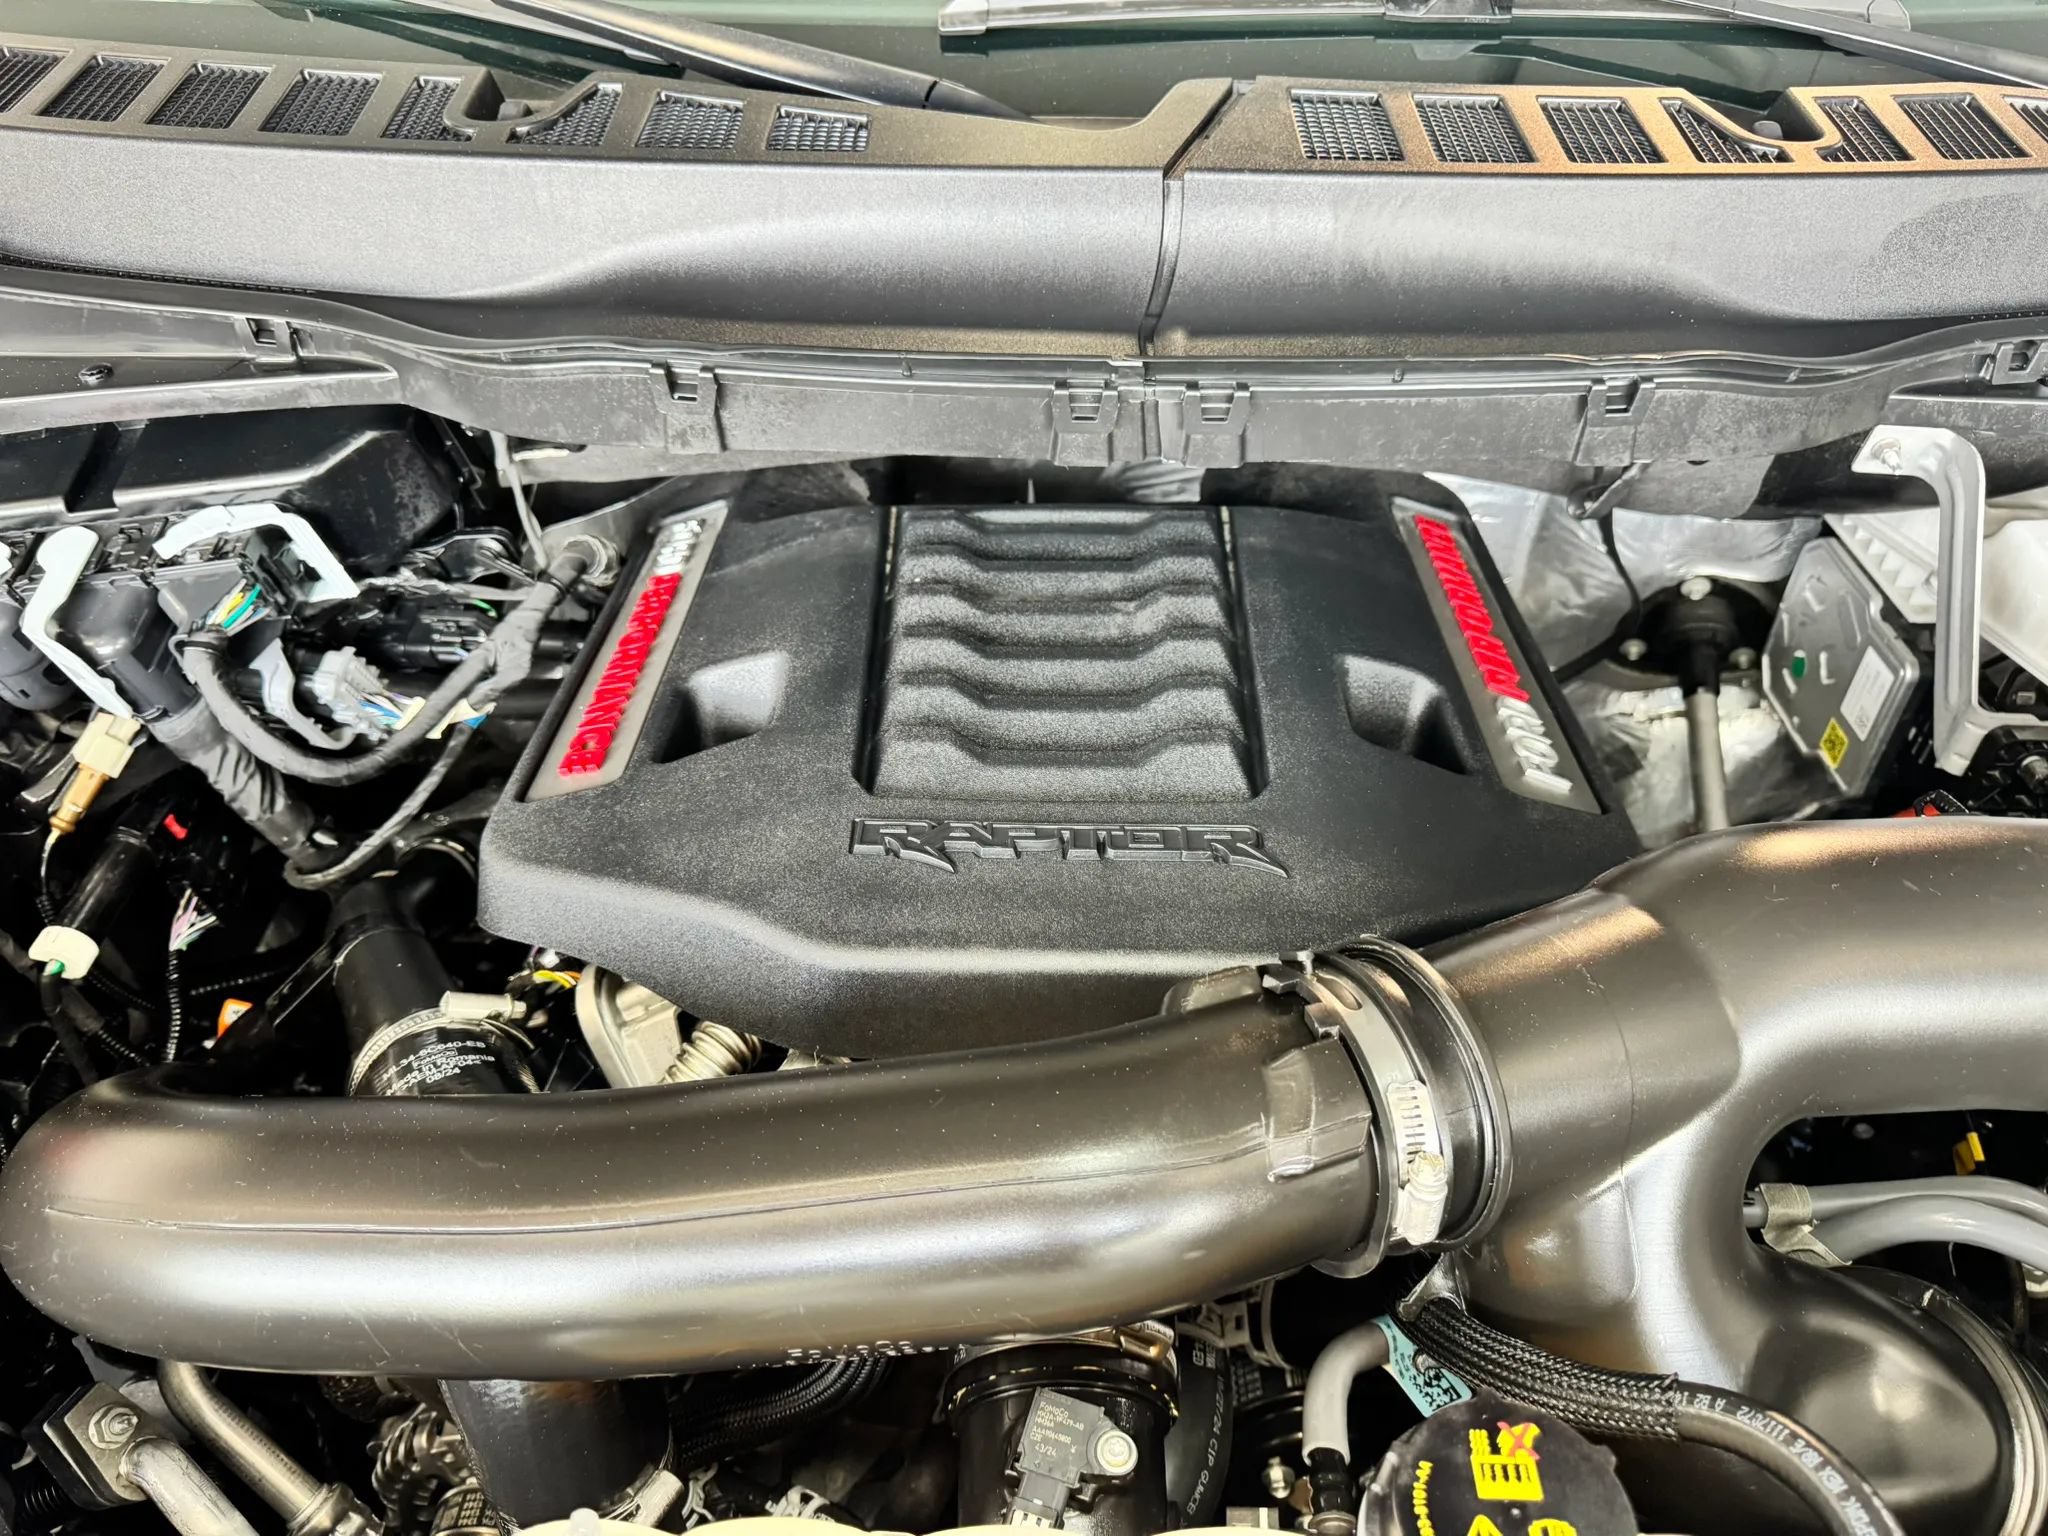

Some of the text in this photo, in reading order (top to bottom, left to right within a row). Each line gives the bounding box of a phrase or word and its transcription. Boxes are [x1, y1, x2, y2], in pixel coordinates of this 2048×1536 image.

[1496, 695, 1573, 795] FORD
[849, 818, 1290, 878] RAPTOR
[436, 1054, 495, 1066] Romania
[1040, 1401, 1069, 1418] FoMoCo
